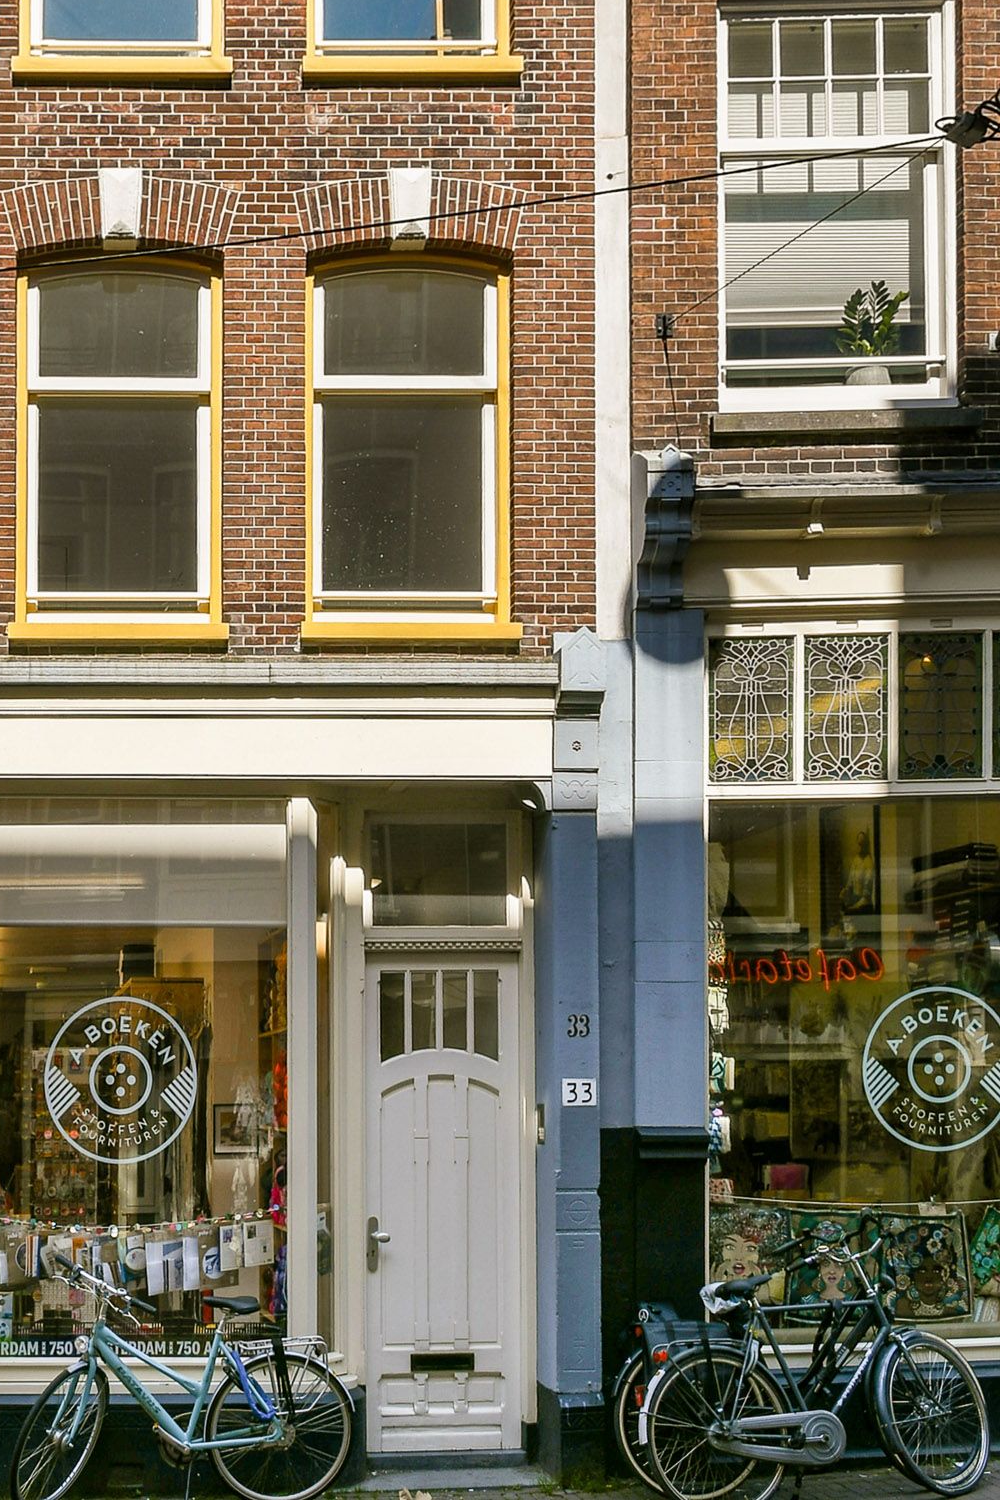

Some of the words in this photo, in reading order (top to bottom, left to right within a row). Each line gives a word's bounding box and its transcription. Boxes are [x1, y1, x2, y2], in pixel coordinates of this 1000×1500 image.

[567, 1014, 590, 1037] 33
[567, 1083, 592, 1103] 33
[82, 1108, 148, 1134] STOFFEN
[150, 1109, 160, 1118] &
[892, 1104, 989, 1135] FOURNITUREN
[901, 1097, 967, 1123] STOFFEN
[970, 1096, 979, 1105] &
[72, 1117, 168, 1147] FOURNITUREN
[49, 1341, 73, 1356] 750
[176, 1341, 200, 1356] 750
